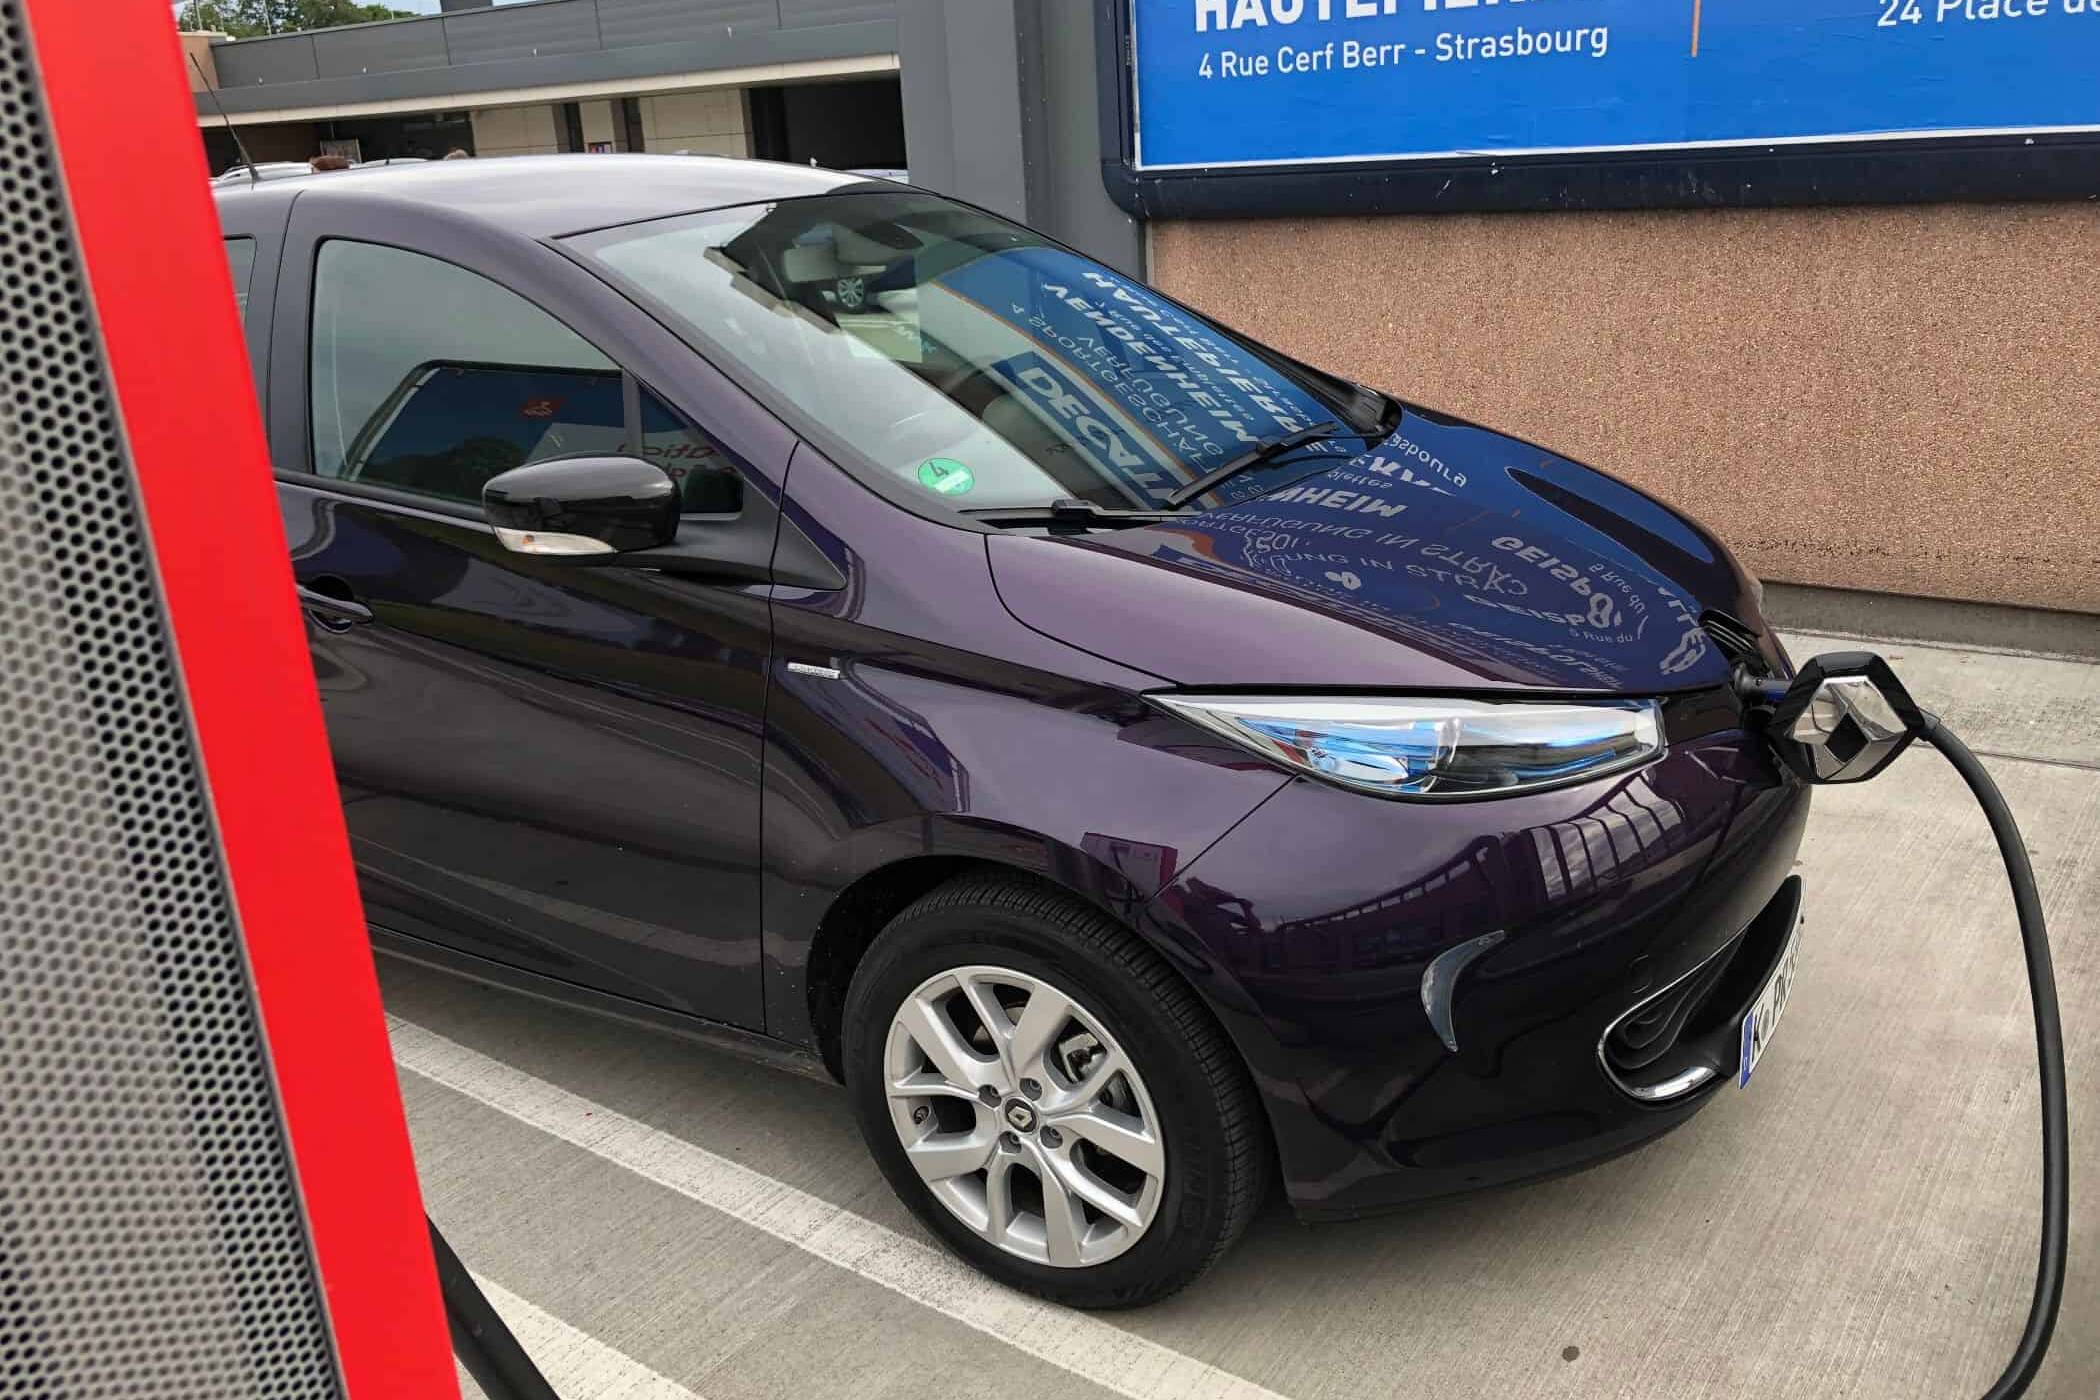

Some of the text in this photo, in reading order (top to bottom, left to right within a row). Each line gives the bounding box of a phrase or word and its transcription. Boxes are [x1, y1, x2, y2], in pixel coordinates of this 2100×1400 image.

[1877, 0, 1922, 27] 24
[1936, 0, 2049, 23] Place
[1198, 52, 1214, 79] 4
[1221, 51, 1269, 78] Rue
[1277, 43, 1334, 73] Cerf
[1343, 40, 1406, 69] Berr
[1435, 26, 1608, 61] Strasbourg
